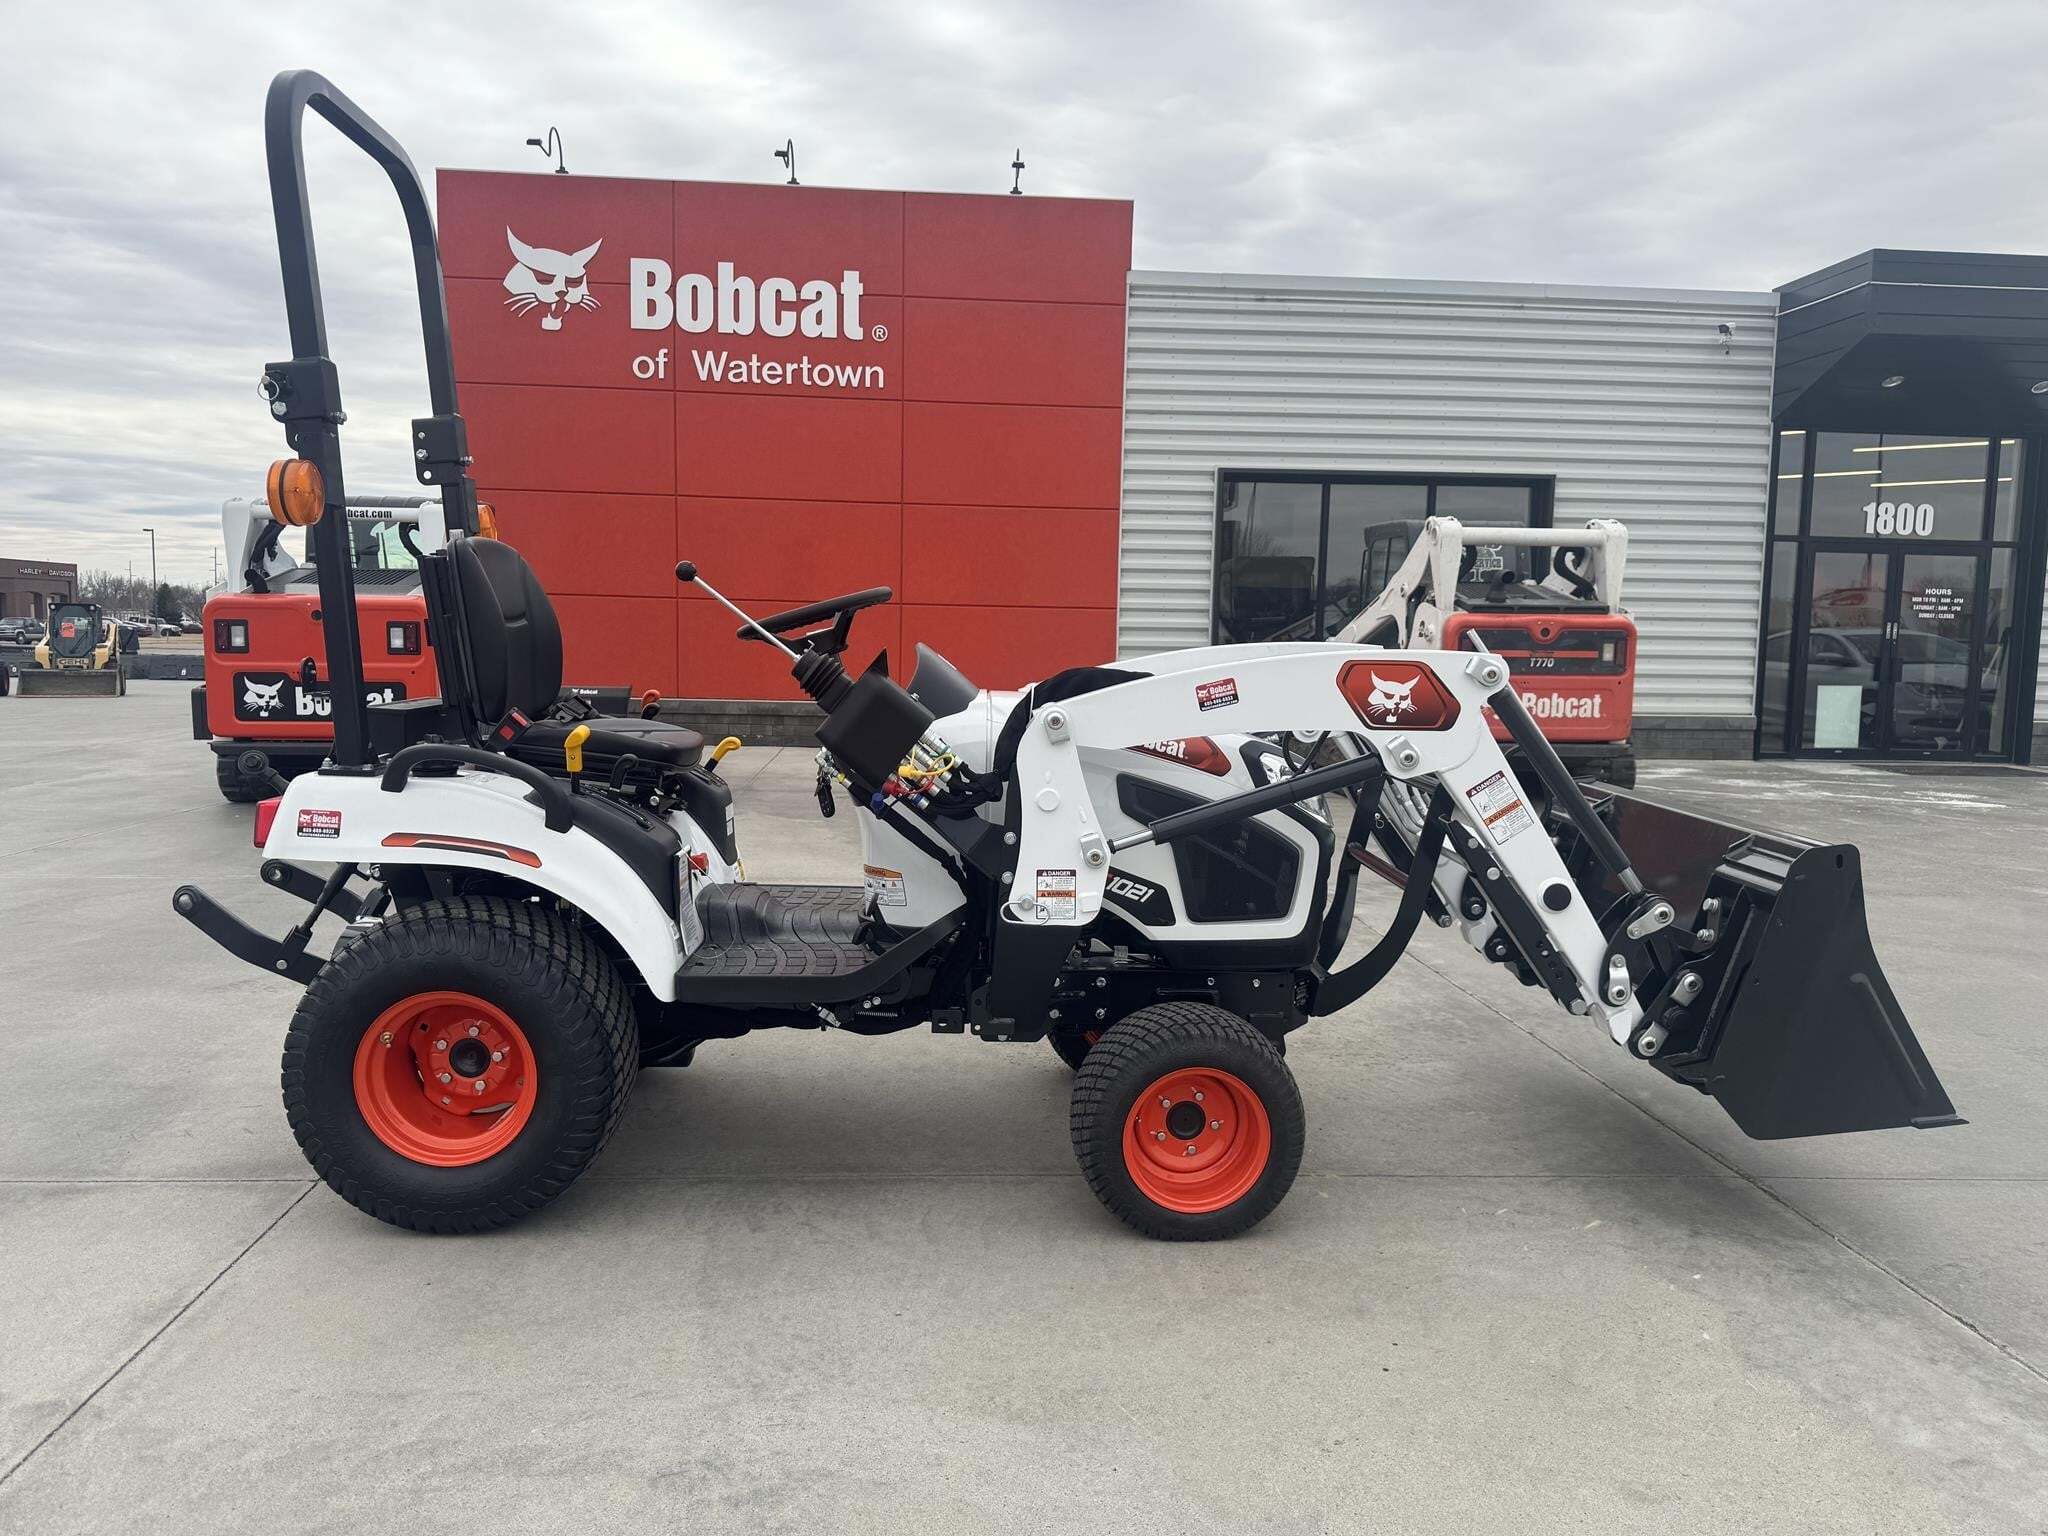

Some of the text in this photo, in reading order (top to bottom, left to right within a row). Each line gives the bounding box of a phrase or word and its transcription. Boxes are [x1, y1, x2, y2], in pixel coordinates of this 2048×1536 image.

[630, 257, 864, 341] Bobcat
[632, 349, 885, 388] of Watertown
[347, 509, 392, 518] bcat.com
[1863, 502, 1935, 536] 1800
[58, 657, 89, 665] GEHL
[1530, 657, 1554, 667] T770
[1210, 682, 1235, 694] Bobcat
[1521, 692, 1602, 718] Bobcat
[1478, 774, 1501, 792] DANGER
[313, 814, 339, 823] Bobcat
